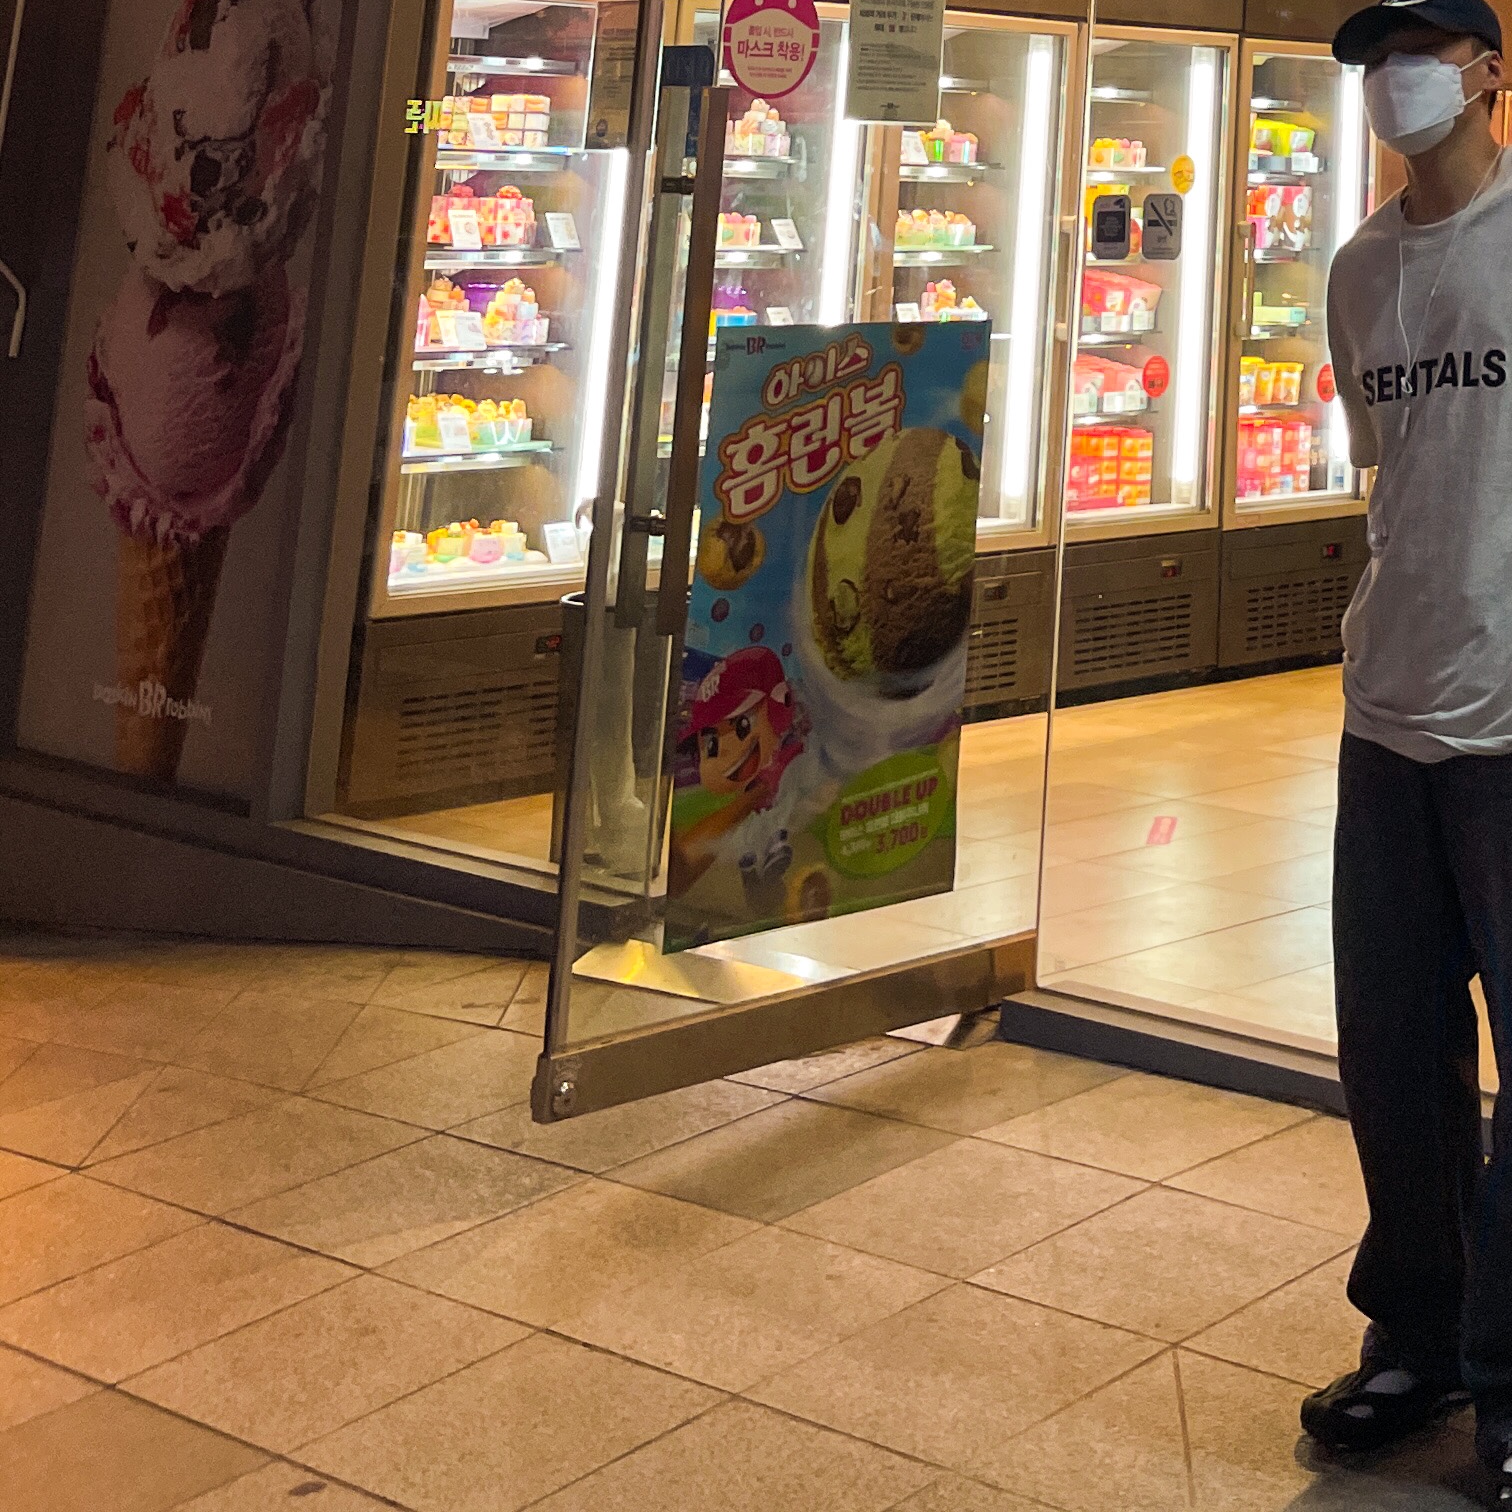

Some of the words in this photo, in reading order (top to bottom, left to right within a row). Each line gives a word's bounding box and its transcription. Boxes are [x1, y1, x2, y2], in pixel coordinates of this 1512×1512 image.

[737, 39, 774, 58] 마스크
[777, 41, 805, 61] 착용!
[765, 335, 870, 406] 아이스
[720, 368, 902, 517] 홈런볼
[841, 786, 912, 826] DOUBLE
[916, 776, 938, 801] UP
